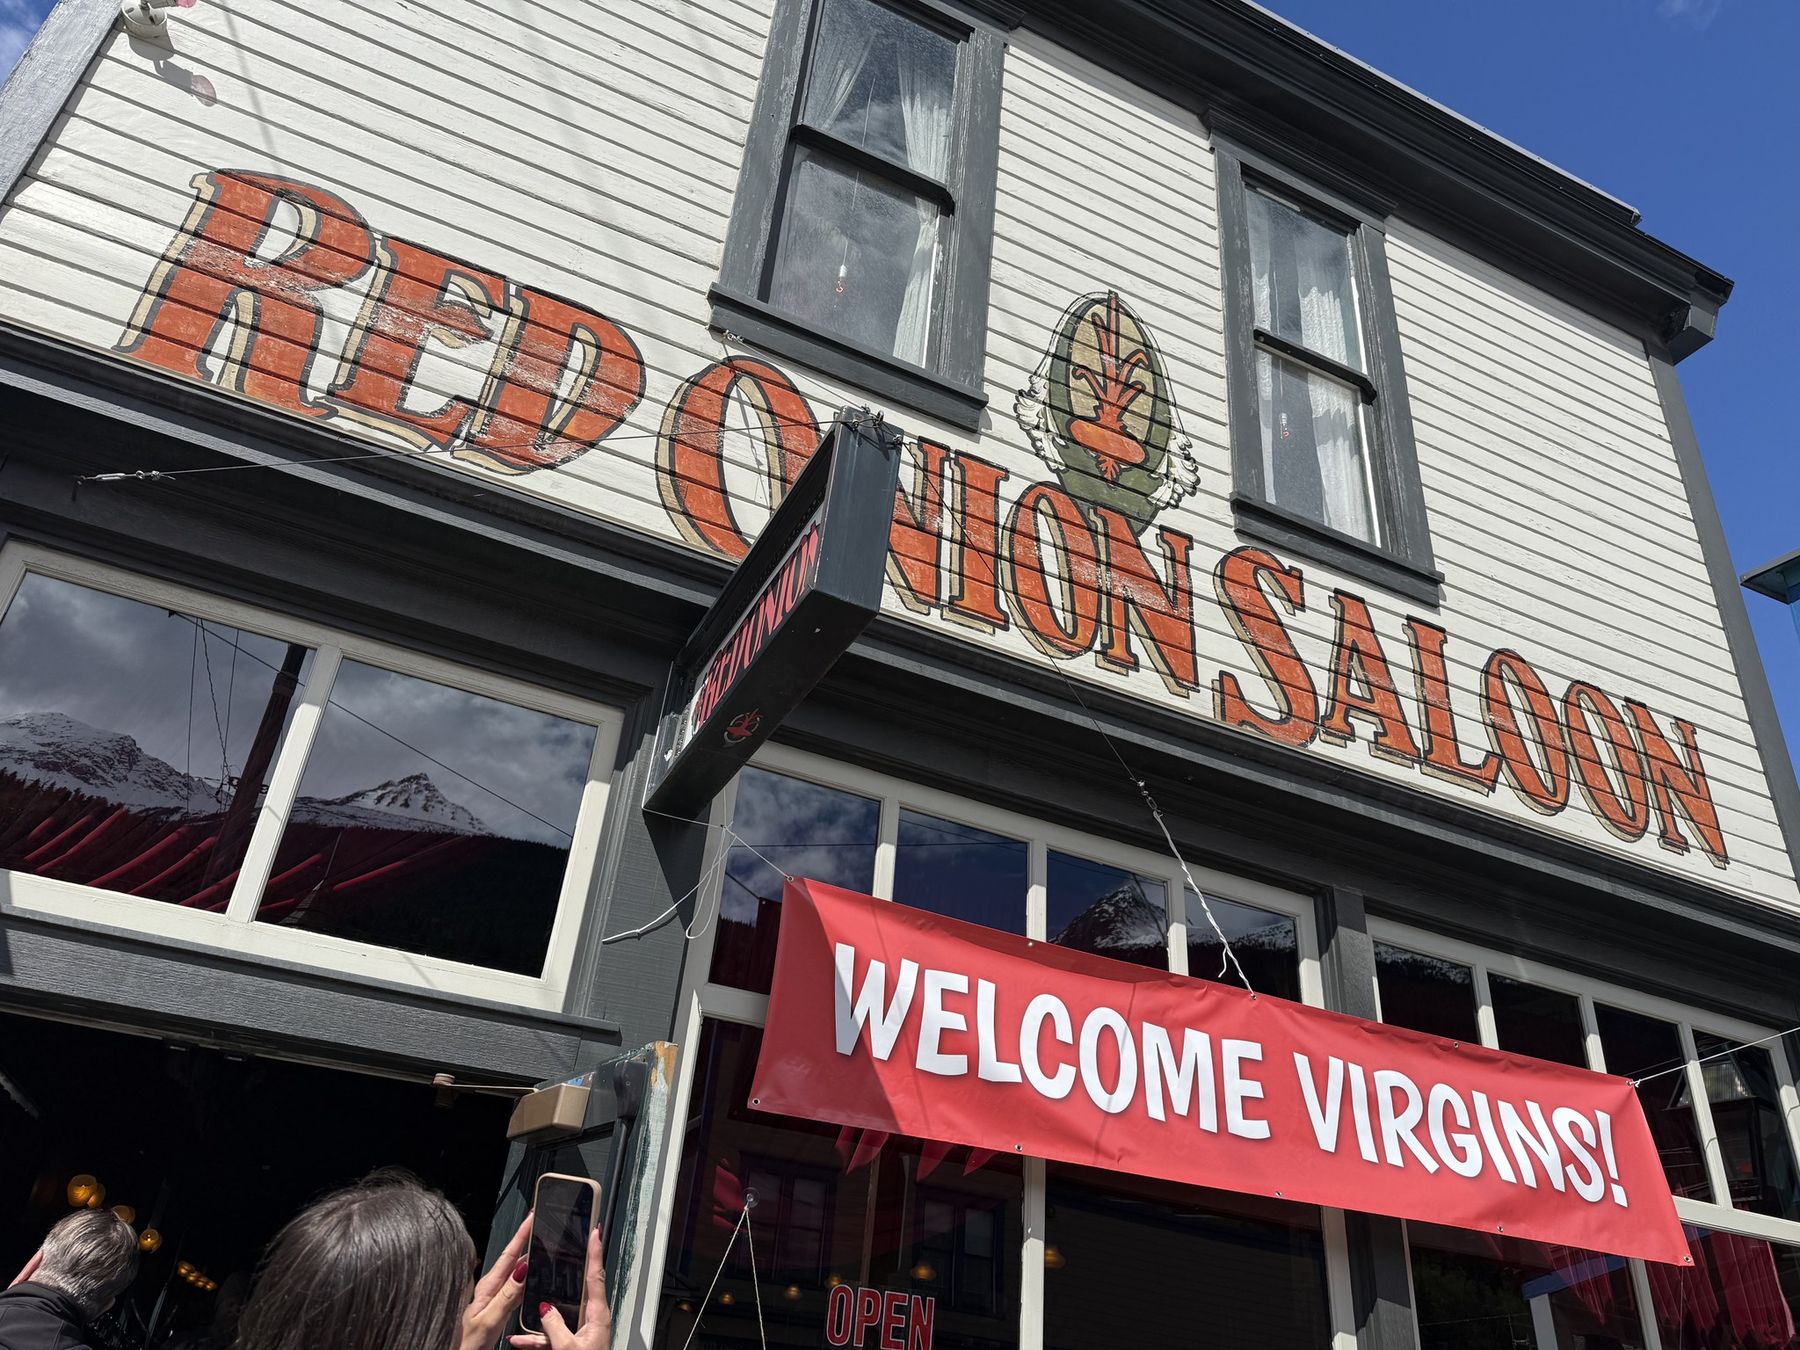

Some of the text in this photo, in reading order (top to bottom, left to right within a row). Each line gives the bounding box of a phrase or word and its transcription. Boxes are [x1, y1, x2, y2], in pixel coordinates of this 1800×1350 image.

[111, 168, 1730, 870] RED ONION SALOON
[834, 942, 1629, 1209] WELCOME VIRGINS!
[826, 1284, 935, 1350] OPEN
